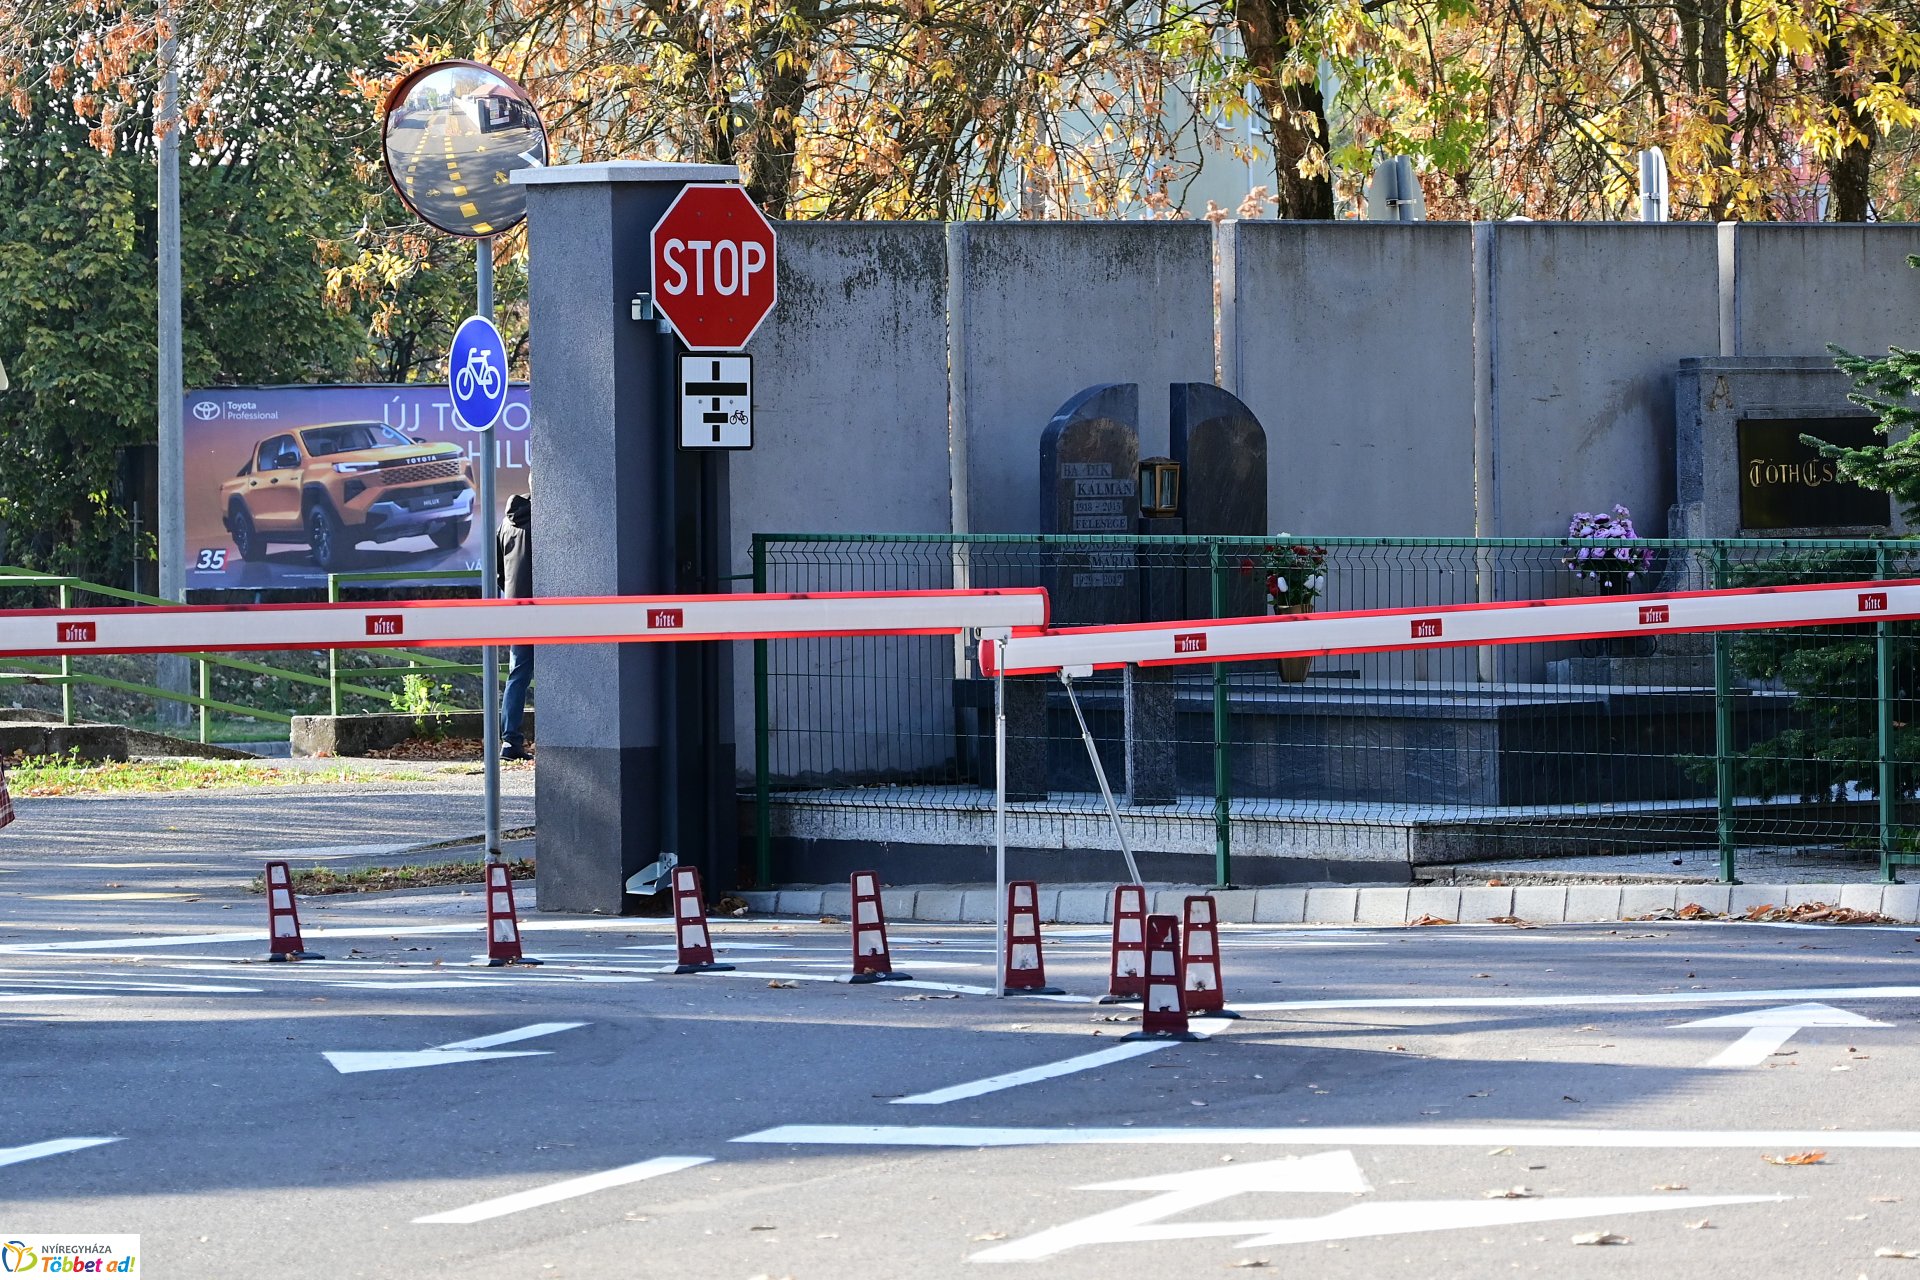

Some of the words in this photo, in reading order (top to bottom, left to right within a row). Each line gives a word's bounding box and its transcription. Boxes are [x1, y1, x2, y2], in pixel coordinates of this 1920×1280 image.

[663, 238, 766, 296] STOP
[227, 401, 257, 412] Toyota
[384, 395, 420, 432] ÚJ
[228, 411, 279, 420] Professional
[405, 455, 437, 464] TOYOTA
[197, 550, 226, 570] 35
